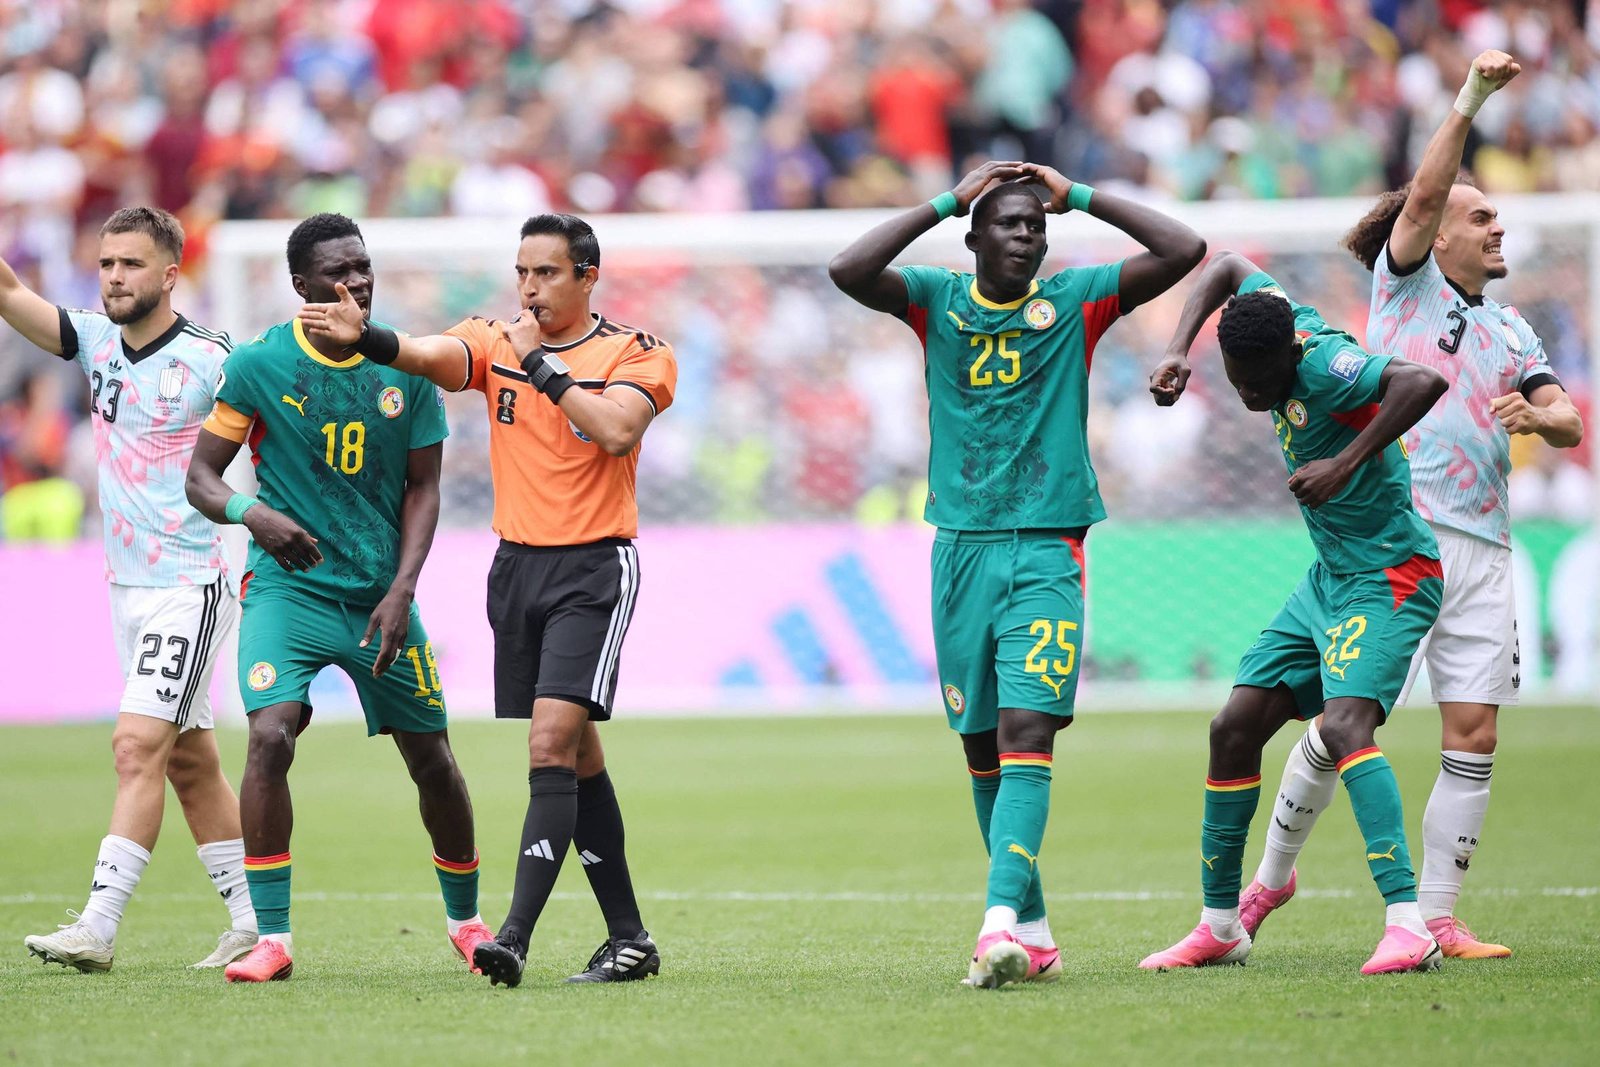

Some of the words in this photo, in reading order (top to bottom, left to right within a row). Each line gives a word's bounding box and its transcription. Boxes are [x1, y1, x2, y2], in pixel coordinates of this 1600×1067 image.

[970, 329, 1022, 386] 25
[1438, 310, 1467, 355] 3
[91, 369, 123, 423] 23
[321, 421, 366, 475] 18
[137, 633, 189, 680] 23
[1024, 619, 1078, 676] 25
[1323, 614, 1368, 667] 22
[1457, 836, 1479, 848] RB
[208, 870, 229, 880] FA
